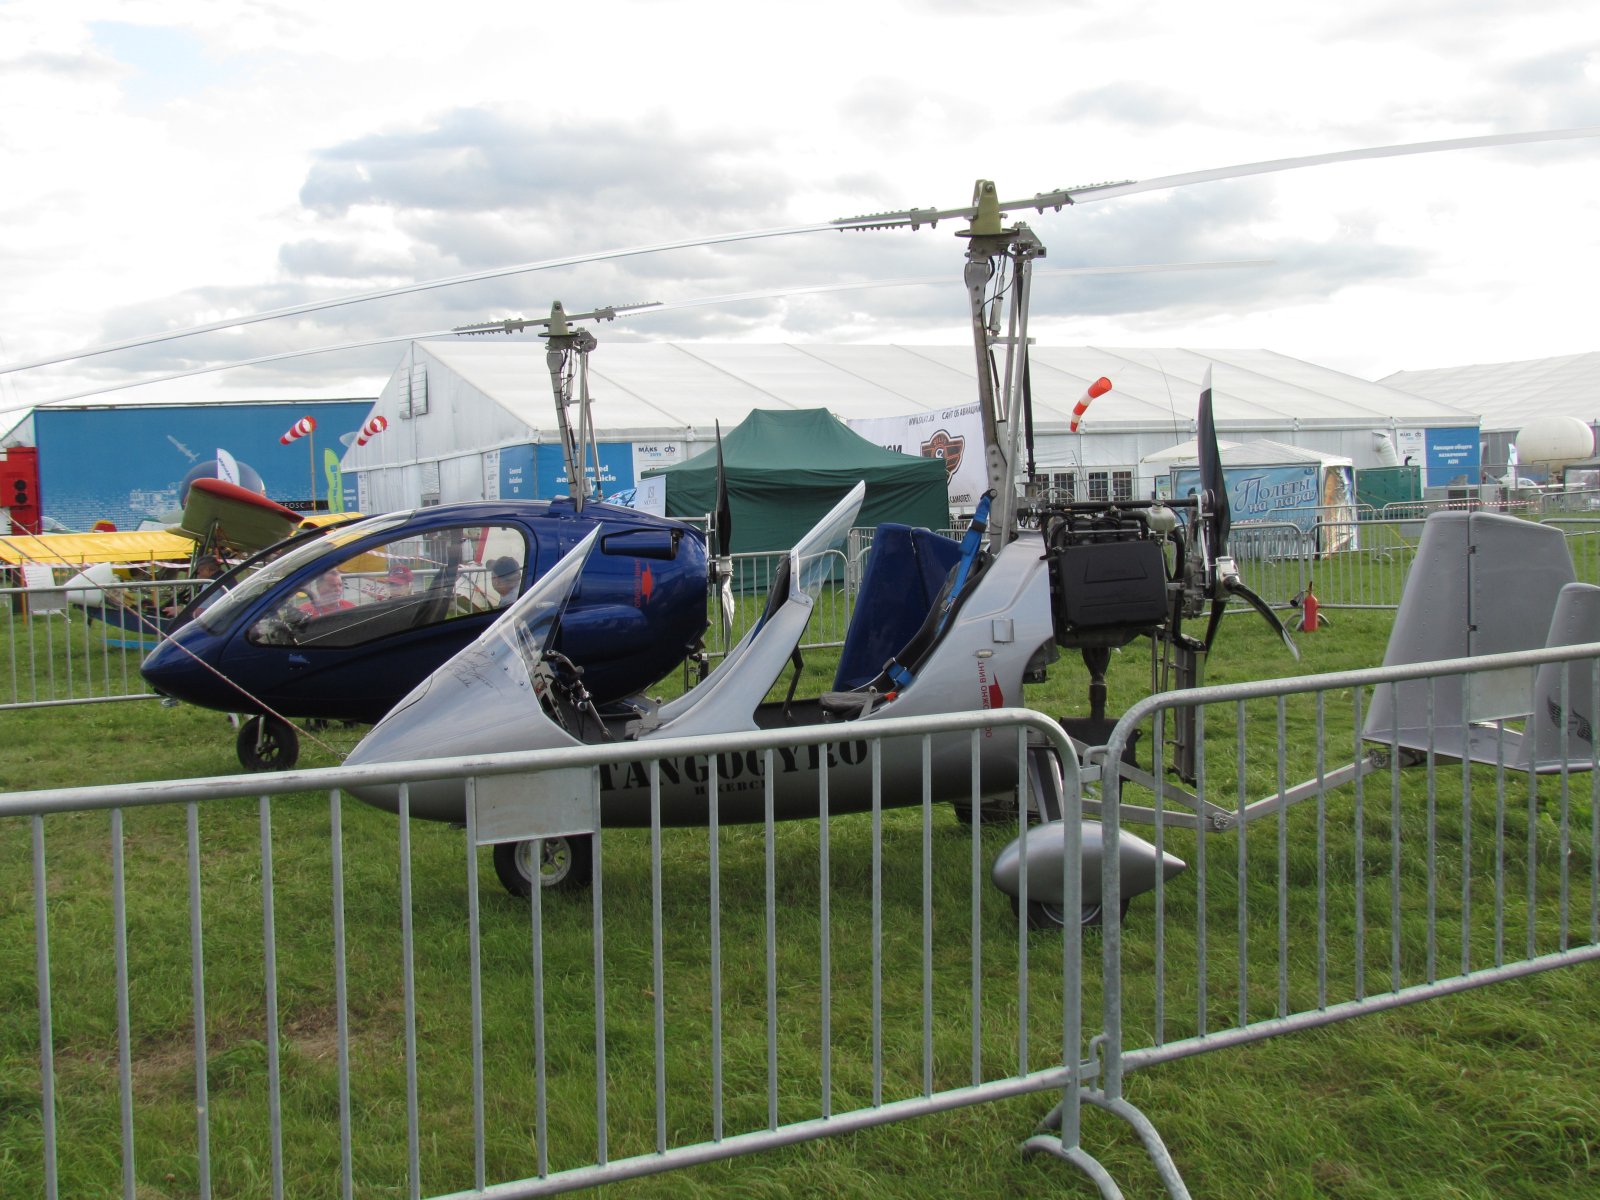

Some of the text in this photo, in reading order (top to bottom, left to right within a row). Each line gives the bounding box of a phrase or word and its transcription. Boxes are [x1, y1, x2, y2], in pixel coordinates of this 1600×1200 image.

[638, 445, 658, 453] MAKS
[1248, 500, 1269, 515] на
[977, 660, 993, 738] ОСОЖНО ВИНТ
